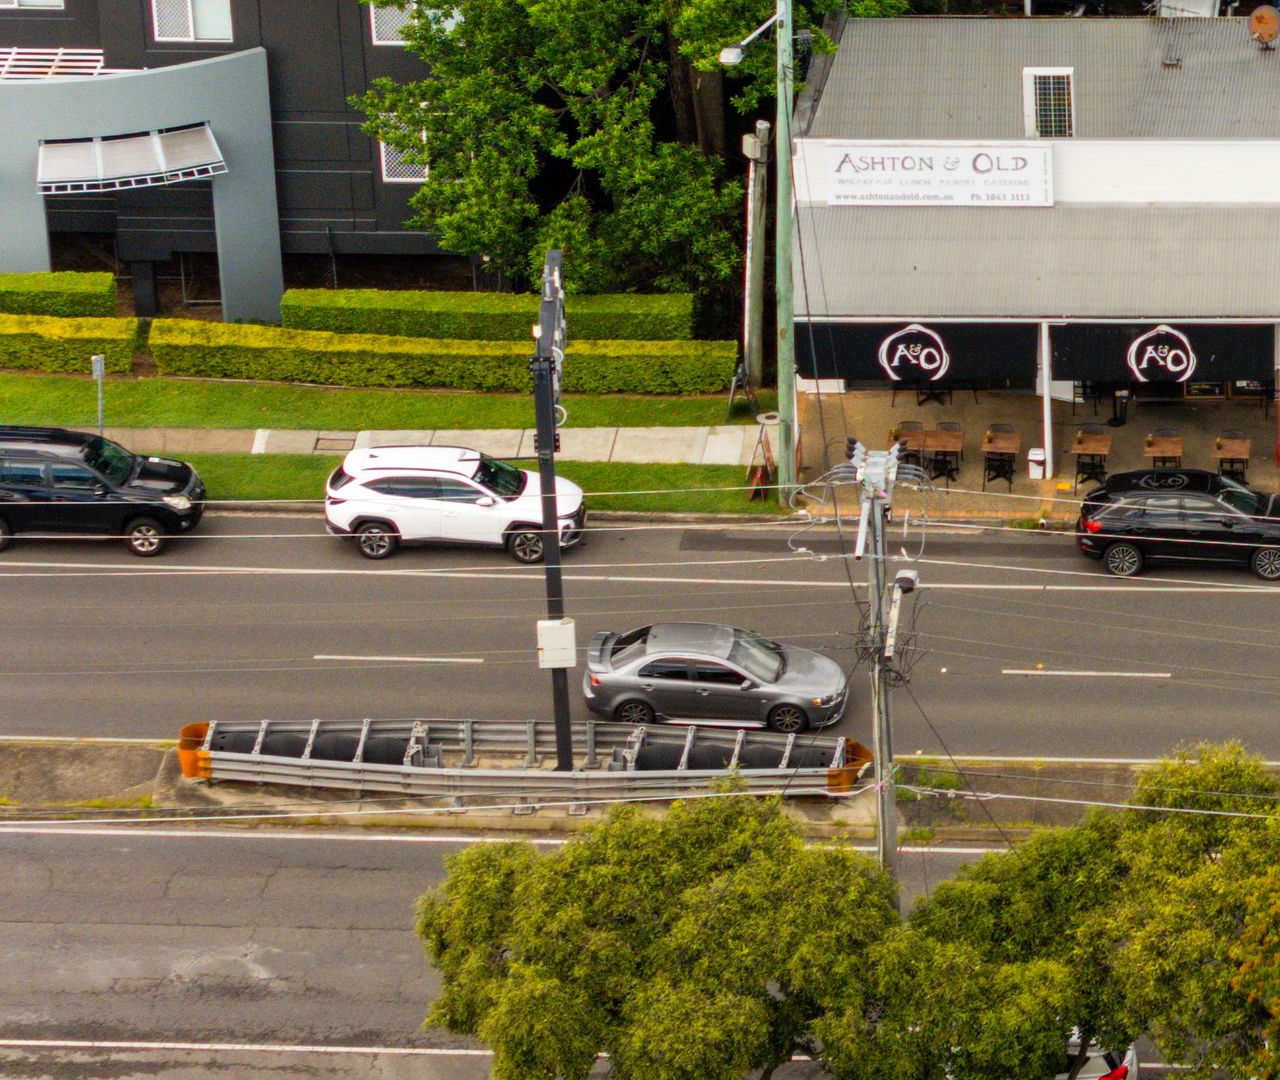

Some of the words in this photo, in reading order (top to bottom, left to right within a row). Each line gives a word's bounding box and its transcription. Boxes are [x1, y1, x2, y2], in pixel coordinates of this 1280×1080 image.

[834, 153, 934, 173] ASHTON
[943, 156, 960, 171] &
[972, 152, 1028, 174] OLD
[838, 178, 892, 186] BREAKFAST
[984, 179, 1029, 187] CATERING
[835, 192, 954, 201] www.ashtonandold.com.au
[970, 193, 982, 201] Ph
